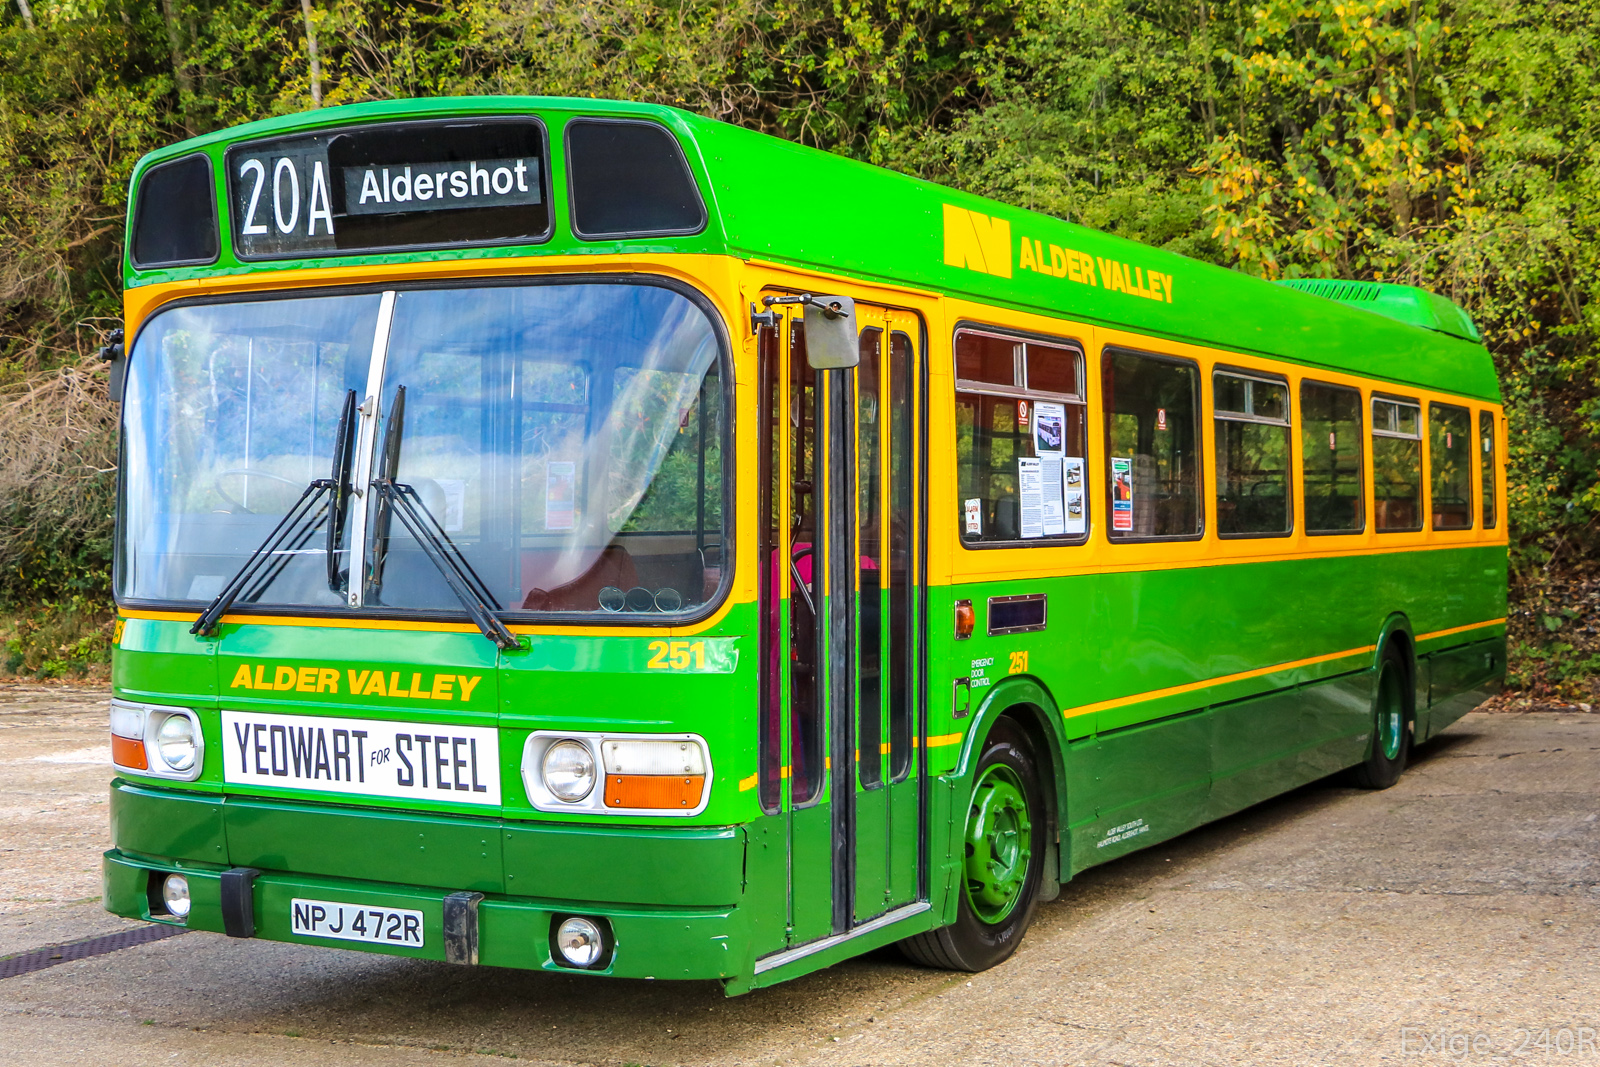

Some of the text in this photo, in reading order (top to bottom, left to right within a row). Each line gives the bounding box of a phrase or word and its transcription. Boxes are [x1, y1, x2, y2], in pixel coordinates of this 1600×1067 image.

[240, 157, 335, 235] 20A
[359, 158, 529, 204] Aldershot
[1019, 236, 1173, 304] ALDER VALLEY
[647, 640, 705, 669] 251
[971, 657, 995, 668] EMERGENCY
[971, 668, 985, 678] DOOR
[1008, 650, 1029, 674] 251
[230, 664, 482, 702] ALDER VALLEY
[971, 677, 991, 688] CONTROL
[233, 722, 487, 793] YEOWART FOR STEEL
[294, 903, 421, 943] NPJ 472R
